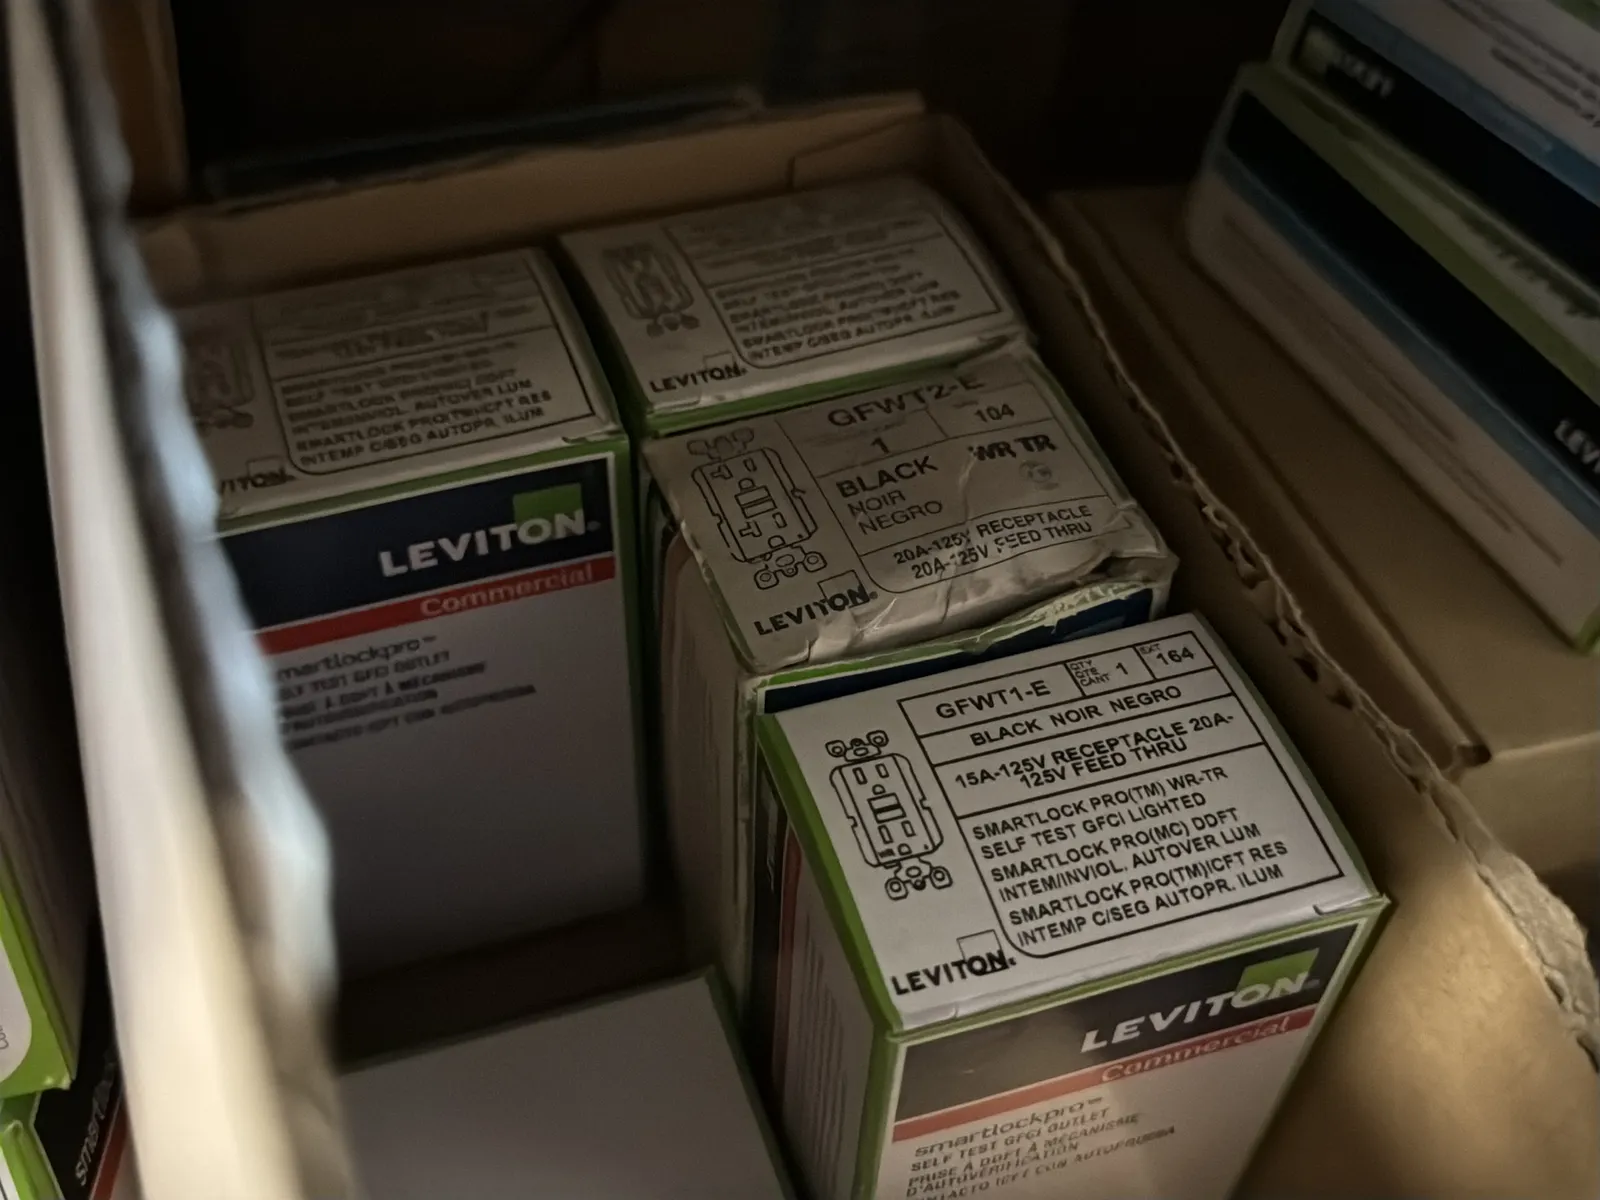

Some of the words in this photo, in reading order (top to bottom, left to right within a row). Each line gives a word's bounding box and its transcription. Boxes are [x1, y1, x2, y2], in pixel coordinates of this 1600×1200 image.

[974, 403, 1016, 424] 104
[869, 437, 890, 455] 1
[1013, 434, 1059, 454] TR
[835, 455, 939, 498] BLACK
[846, 489, 908, 517] NOIR
[857, 500, 943, 535] NEGRO
[975, 504, 1093, 538] RECEPTACLE
[379, 507, 587, 578] LEVITON
[995, 531, 1042, 555] FEED
[1045, 521, 1094, 541] THRU
[419, 562, 594, 618] Commercial
[754, 581, 870, 636] LEVITON
[278, 639, 421, 681] martlockpro
[1115, 662, 1129, 675] 1
[1155, 646, 1195, 666] 164
[936, 679, 1051, 719] GFWT1-E
[969, 719, 1044, 746] BLACK
[1049, 704, 1104, 729] NOIR
[1109, 685, 1182, 713] NEGRO
[955, 754, 1046, 789] 15A-125V
[1050, 720, 1189, 765] RECEPTACLE
[1190, 713, 1235, 735] 20A-
[1020, 765, 1066, 789] 125V
[1072, 753, 1127, 777] FEED
[1129, 737, 1188, 763] THRU
[972, 800, 1089, 841] SMARTLOCK
[1089, 779, 1167, 812] PRO(TM)
[1165, 765, 1229, 793] WR-TR
[980, 837, 1026, 860] SELF
[1032, 823, 1078, 848] TEST
[1081, 811, 1127, 834] GFCI
[1129, 791, 1207, 821] LIGHTED
[990, 842, 1108, 882] SMARTLOCK
[1110, 819, 1190, 853] PRO(MC)
[1193, 806, 1240, 830] DDFT
[1131, 834, 1218, 868] AUTOVER
[1223, 822, 1262, 845] LUM
[1008, 881, 1128, 926] SMARTLOCK
[1249, 841, 1289, 862] RES
[1017, 917, 1088, 948] INTEMP
[1091, 900, 1150, 927] C/SEG
[1155, 877, 1237, 910] AUTOPR.
[1238, 863, 1286, 888] ILUM
[891, 950, 1008, 996] LEVITON
[1080, 970, 1310, 1053] LEVITON
[1100, 1017, 1291, 1082] Commercial
[959, 1139, 999, 1159] TEST
